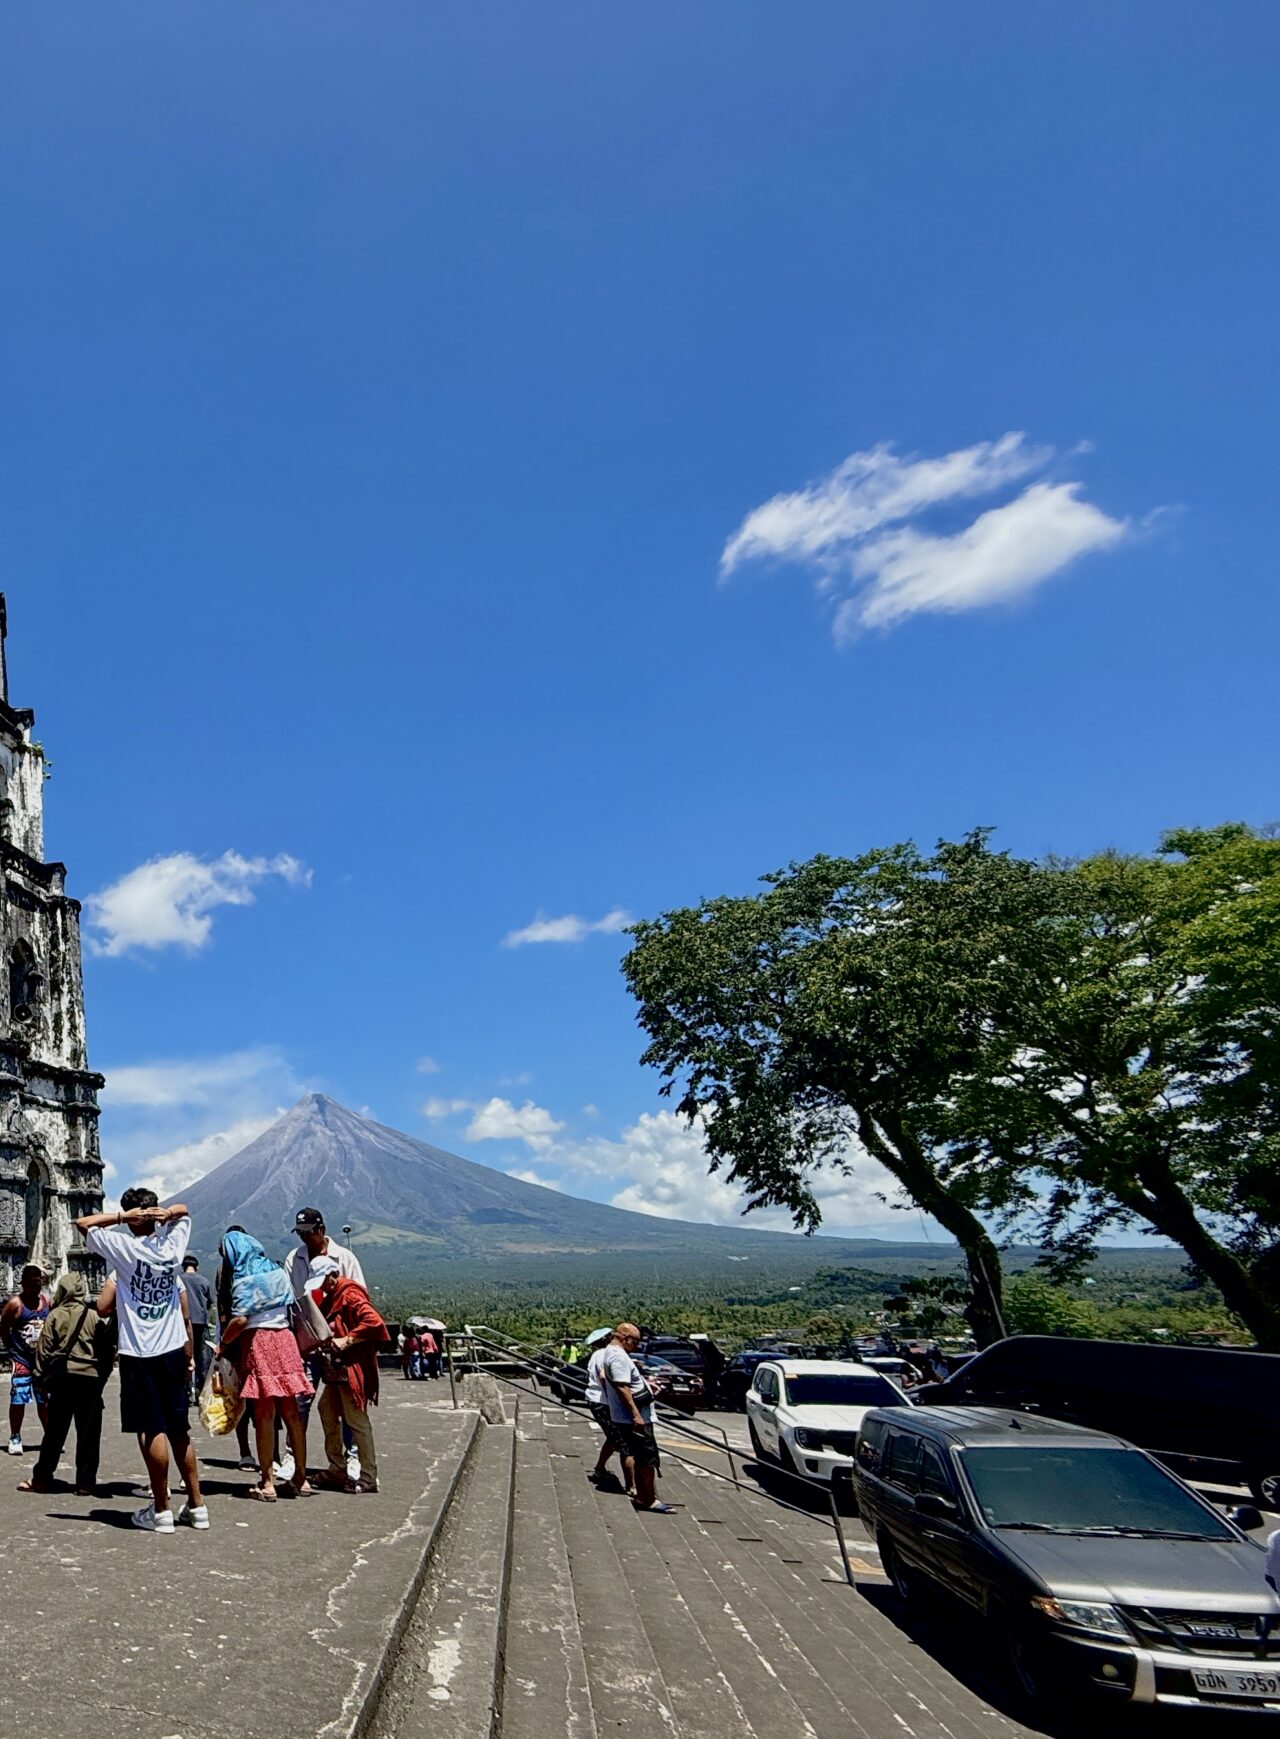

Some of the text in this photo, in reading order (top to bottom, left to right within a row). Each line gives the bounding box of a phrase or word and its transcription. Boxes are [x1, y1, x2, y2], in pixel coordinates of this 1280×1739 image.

[130, 1275, 174, 1292] NEVER
[1190, 1625, 1237, 1637] ISUZU
[1195, 1673, 1277, 1692] GDN 3959
